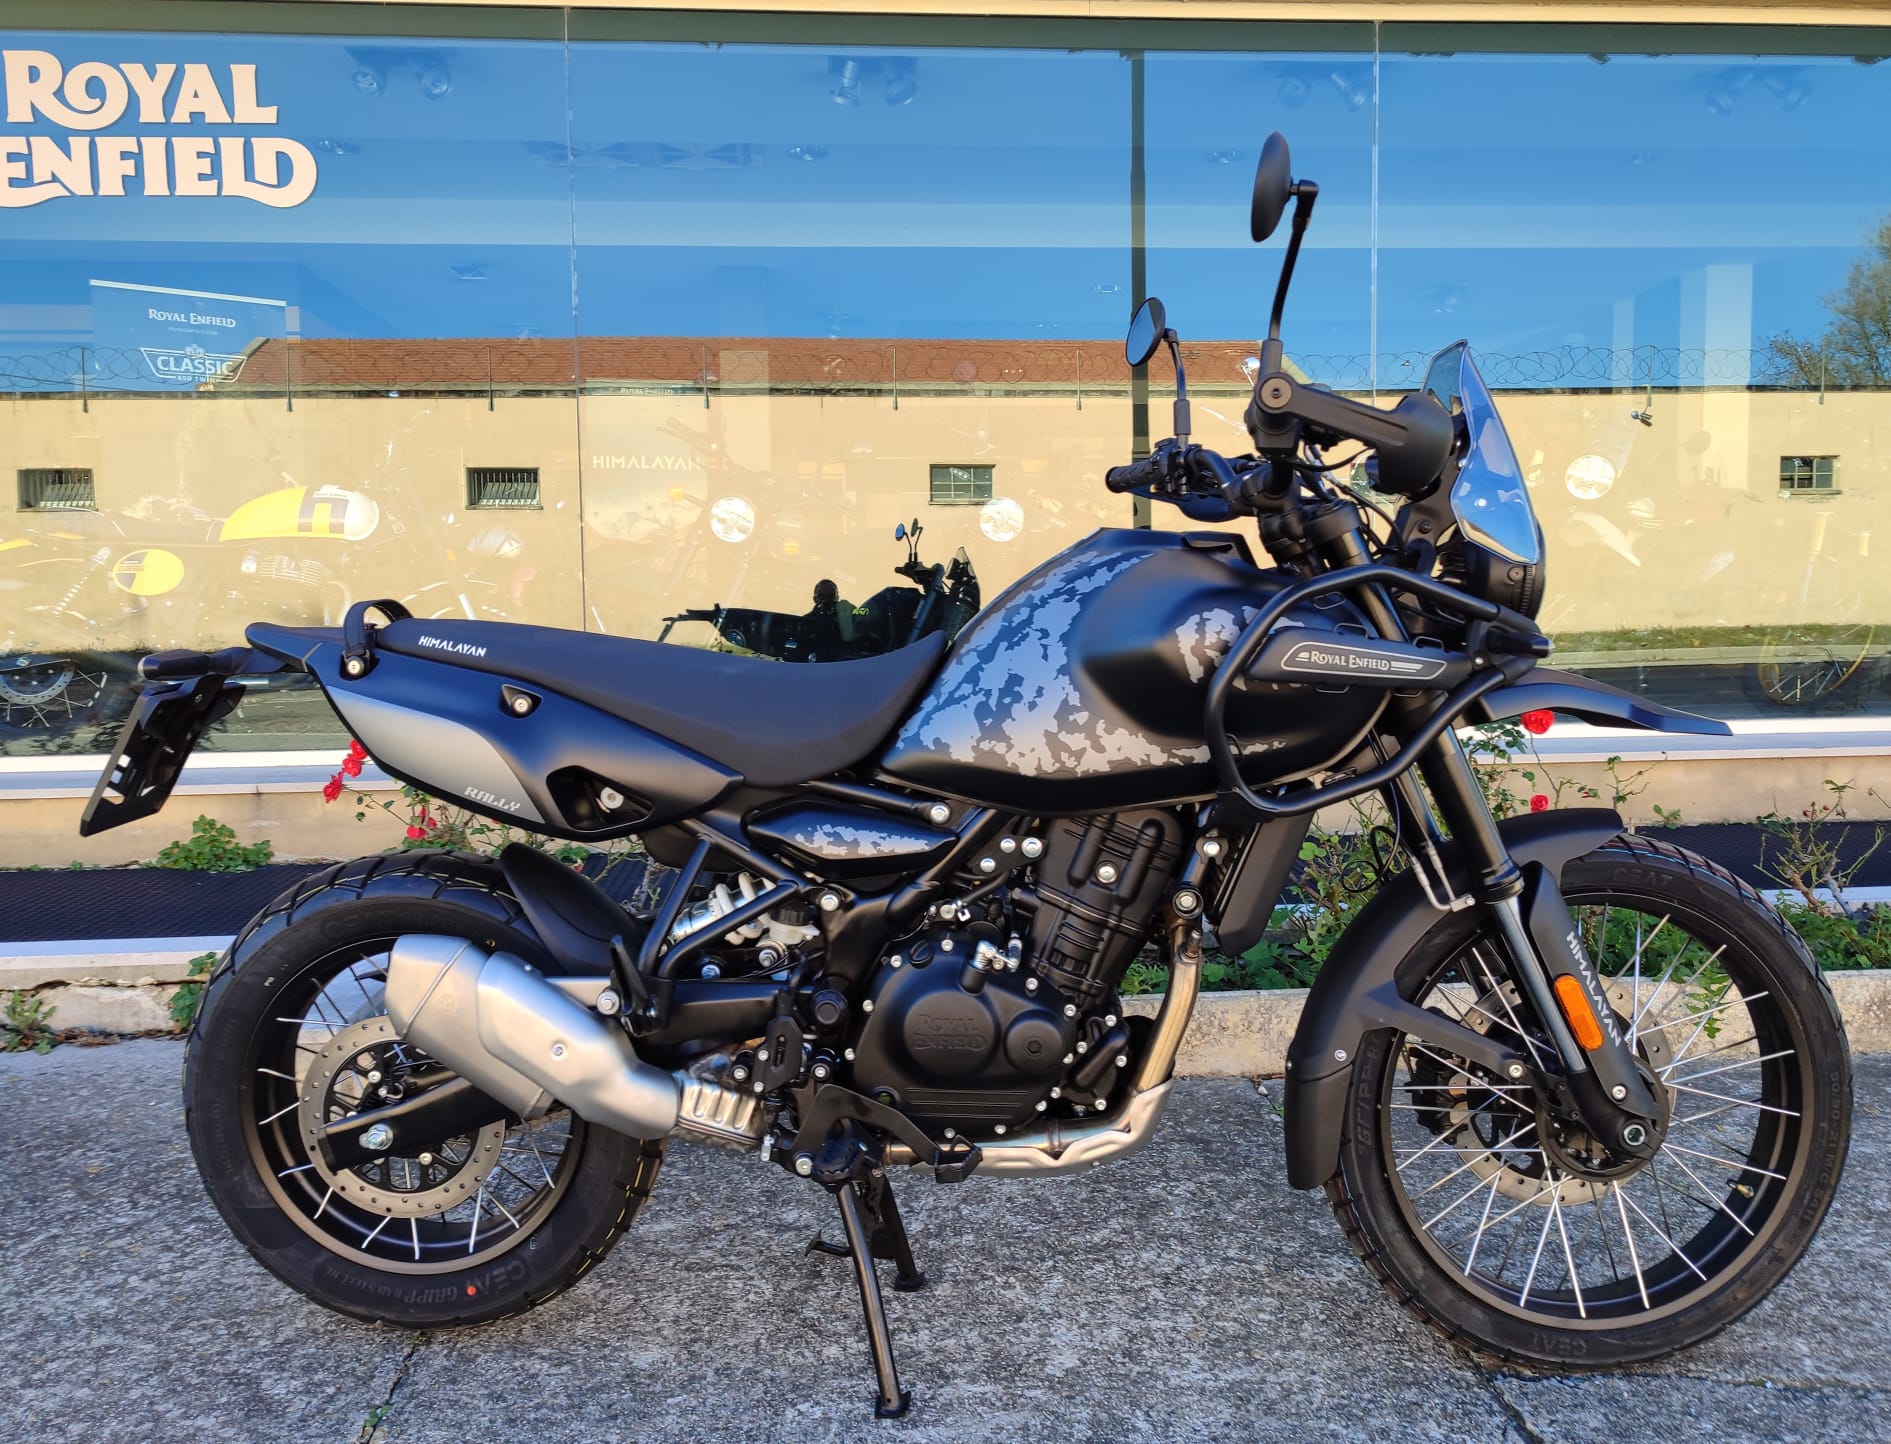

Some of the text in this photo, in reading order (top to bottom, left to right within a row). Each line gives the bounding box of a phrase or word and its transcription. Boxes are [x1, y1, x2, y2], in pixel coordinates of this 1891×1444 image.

[3, 50, 278, 131] ROYAL
[0, 136, 318, 208] ENFIELD
[148, 308, 237, 328] ROYAL ENFIELD
[157, 356, 234, 376] CLASSIC
[593, 456, 701, 470] HIMALAYAN
[418, 635, 487, 658] HIMALAYAN
[1311, 651, 1390, 671] ROYAL ENFIELD
[464, 786, 521, 812] RALLY
[1566, 931, 1621, 1047] HIMALAYAN
[918, 1014, 979, 1033] ROYAL
[912, 1032, 987, 1052] ENFIELD
[404, 1286, 458, 1304] GRIPP
